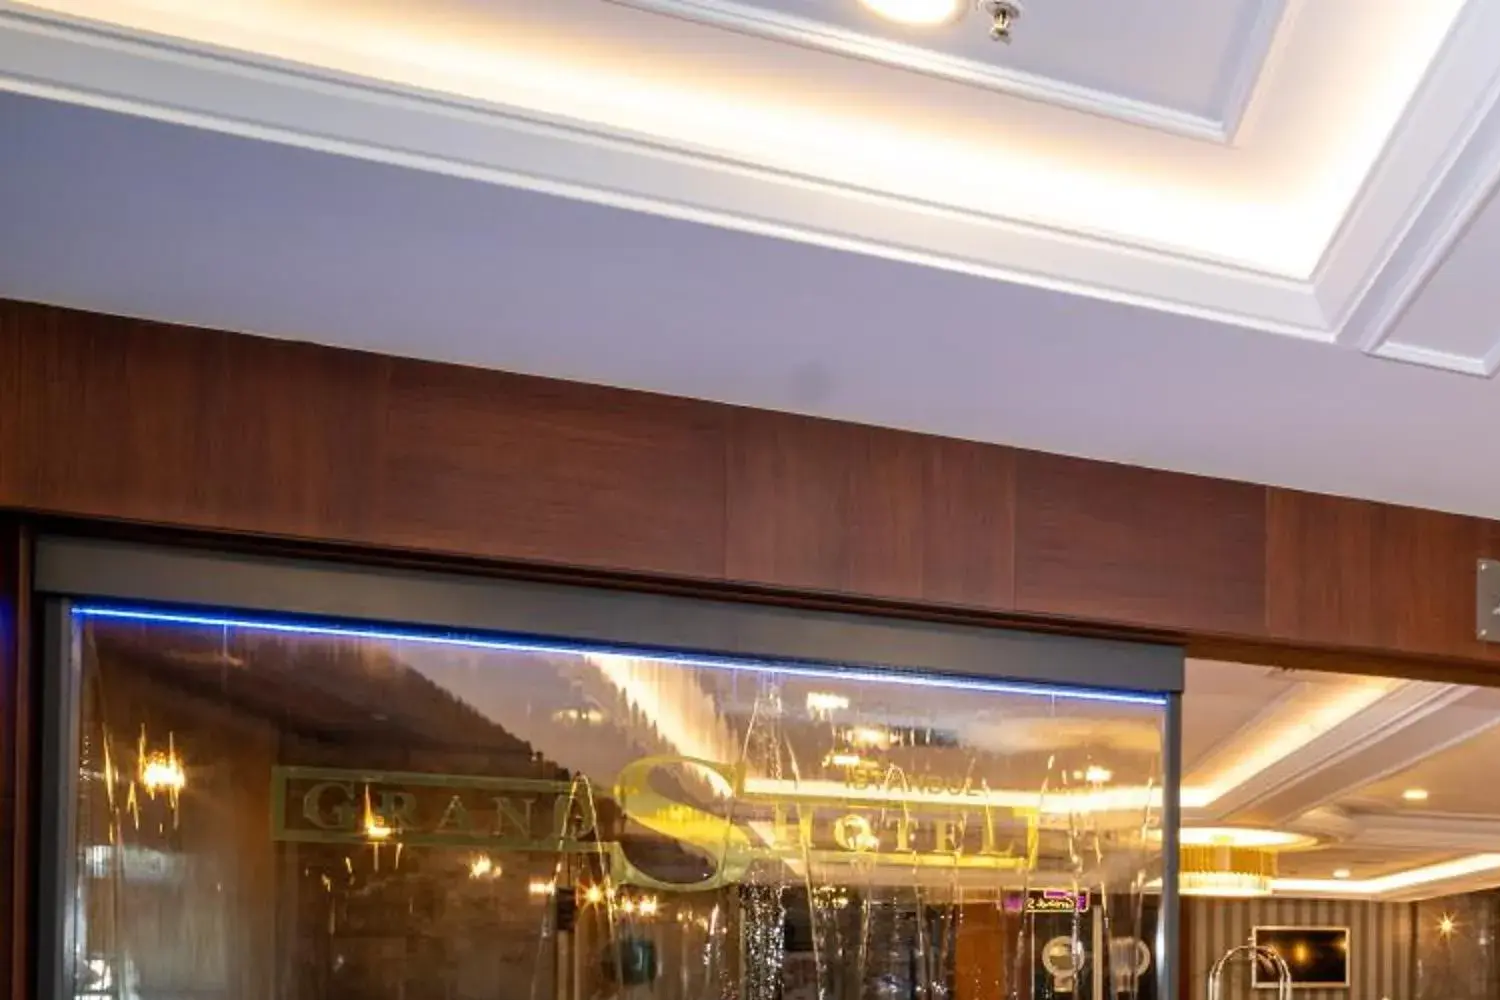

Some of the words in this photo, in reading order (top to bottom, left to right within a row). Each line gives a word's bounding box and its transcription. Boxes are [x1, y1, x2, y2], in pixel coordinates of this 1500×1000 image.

[303, 780, 599, 844] GRAND
[613, 755, 753, 893] S
[771, 804, 1017, 858] HOTEL
